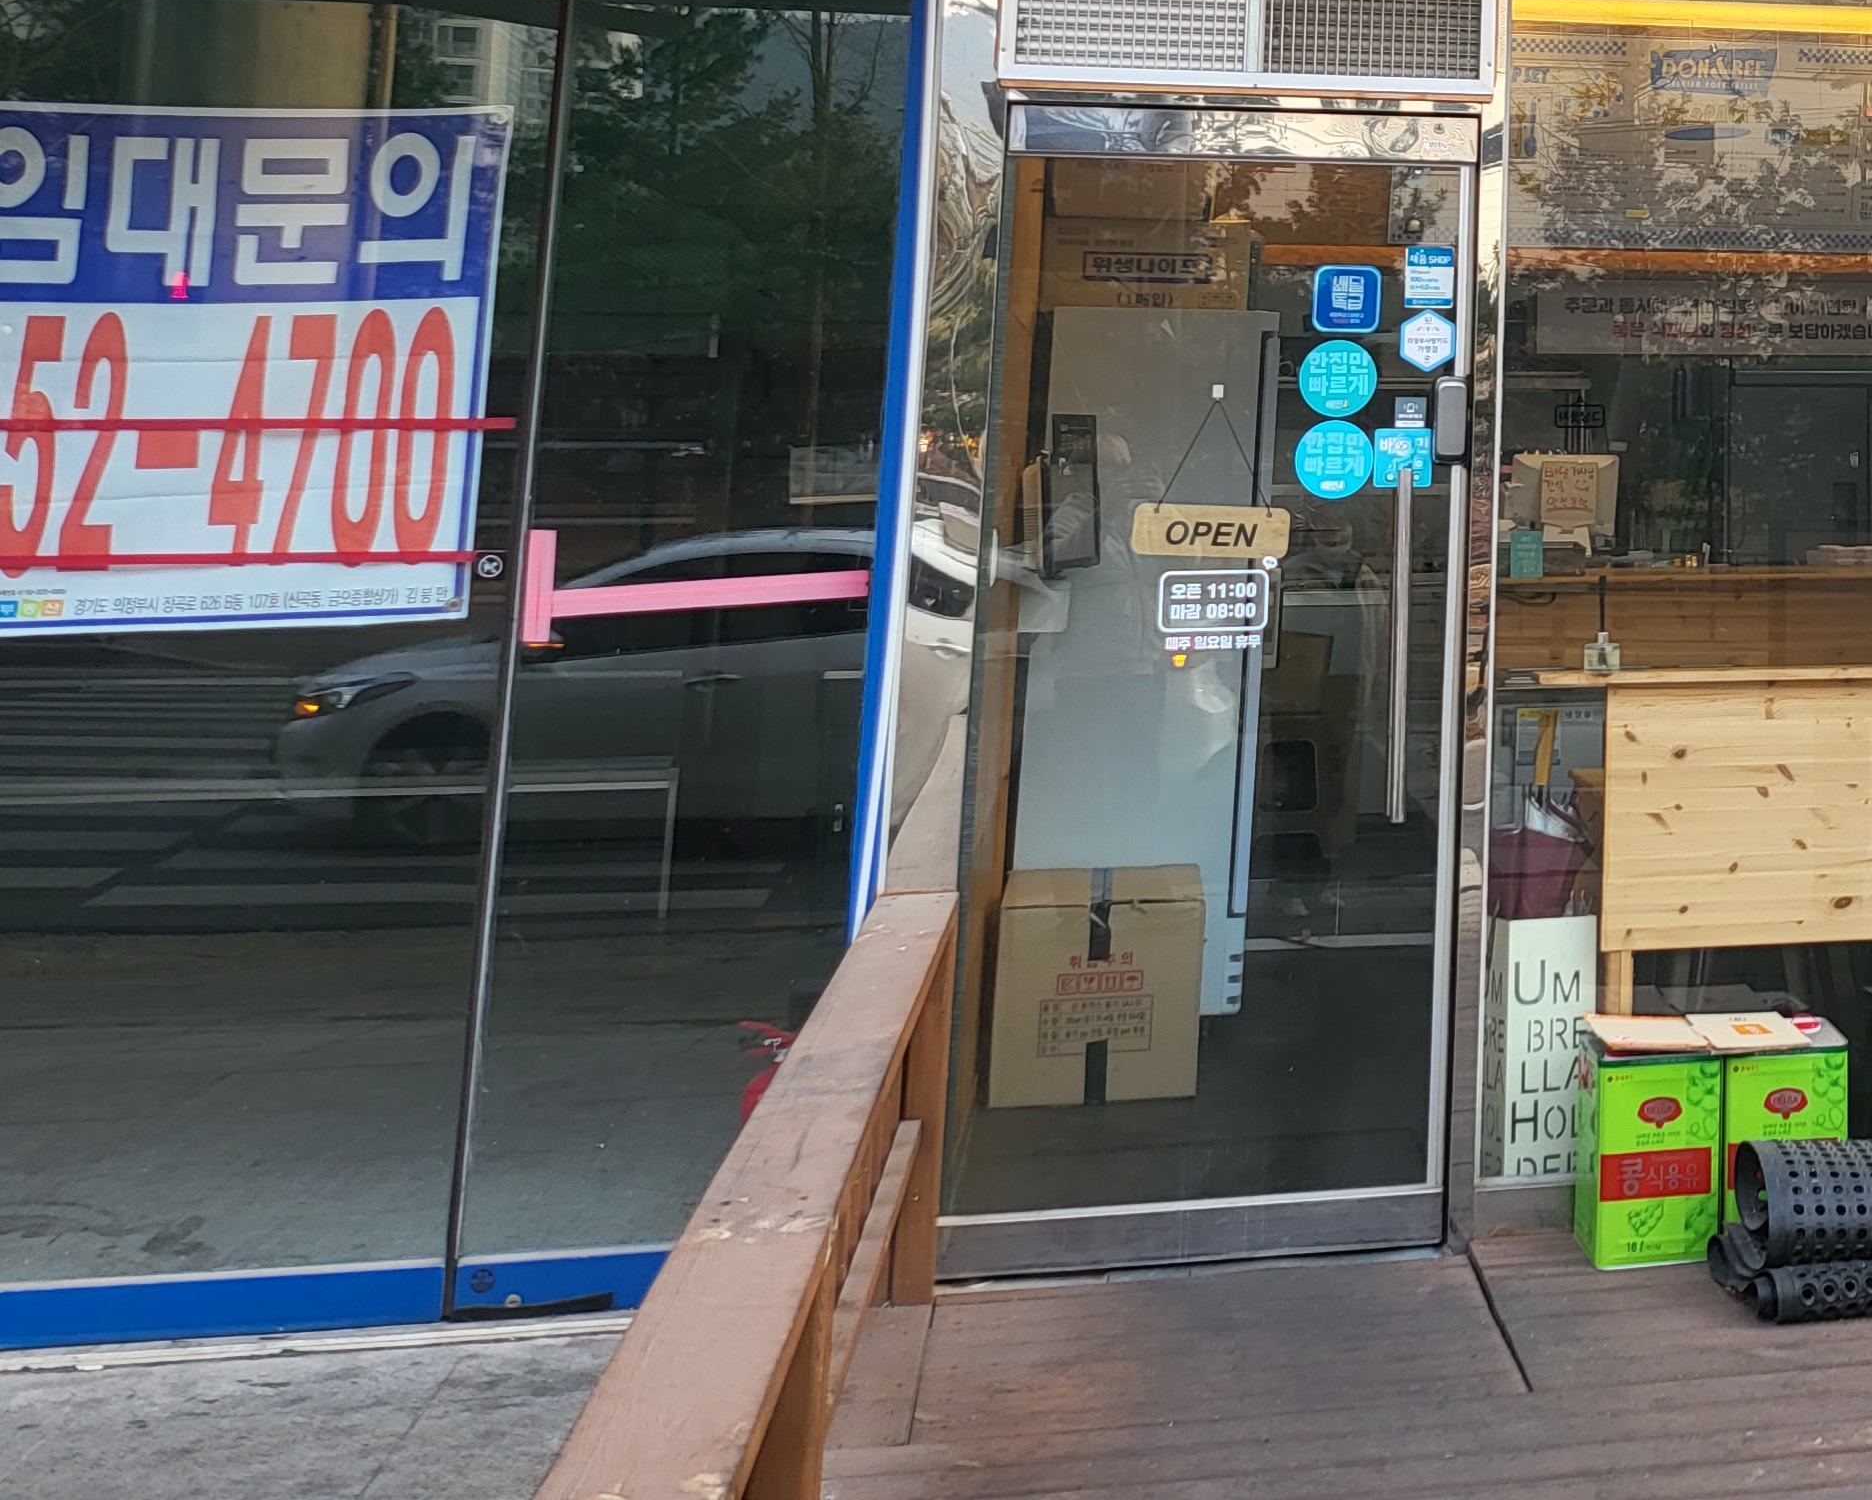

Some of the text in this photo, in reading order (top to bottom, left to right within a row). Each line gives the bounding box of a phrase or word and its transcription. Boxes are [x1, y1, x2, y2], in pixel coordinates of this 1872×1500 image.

[0, 127, 478, 287] 임대문의
[1428, 255, 1452, 264] SHOP
[1308, 351, 1370, 374] 한집만
[1308, 375, 1369, 397] 빠르게
[1303, 431, 1365, 454] 한집만
[1303, 455, 1366, 477] 빠르게
[1165, 520, 1258, 547] OPEN
[1170, 582, 1257, 599] 오픈 11:00
[73, 598, 110, 616] 경기도
[112, 596, 160, 615] 의정부시
[248, 592, 280, 609] 107호
[1170, 602, 1256, 620] 마감 08:00
[1164, 634, 1261, 650] 매주 일요일 휴무
[1620, 1157, 1699, 1197] 콩식용유
